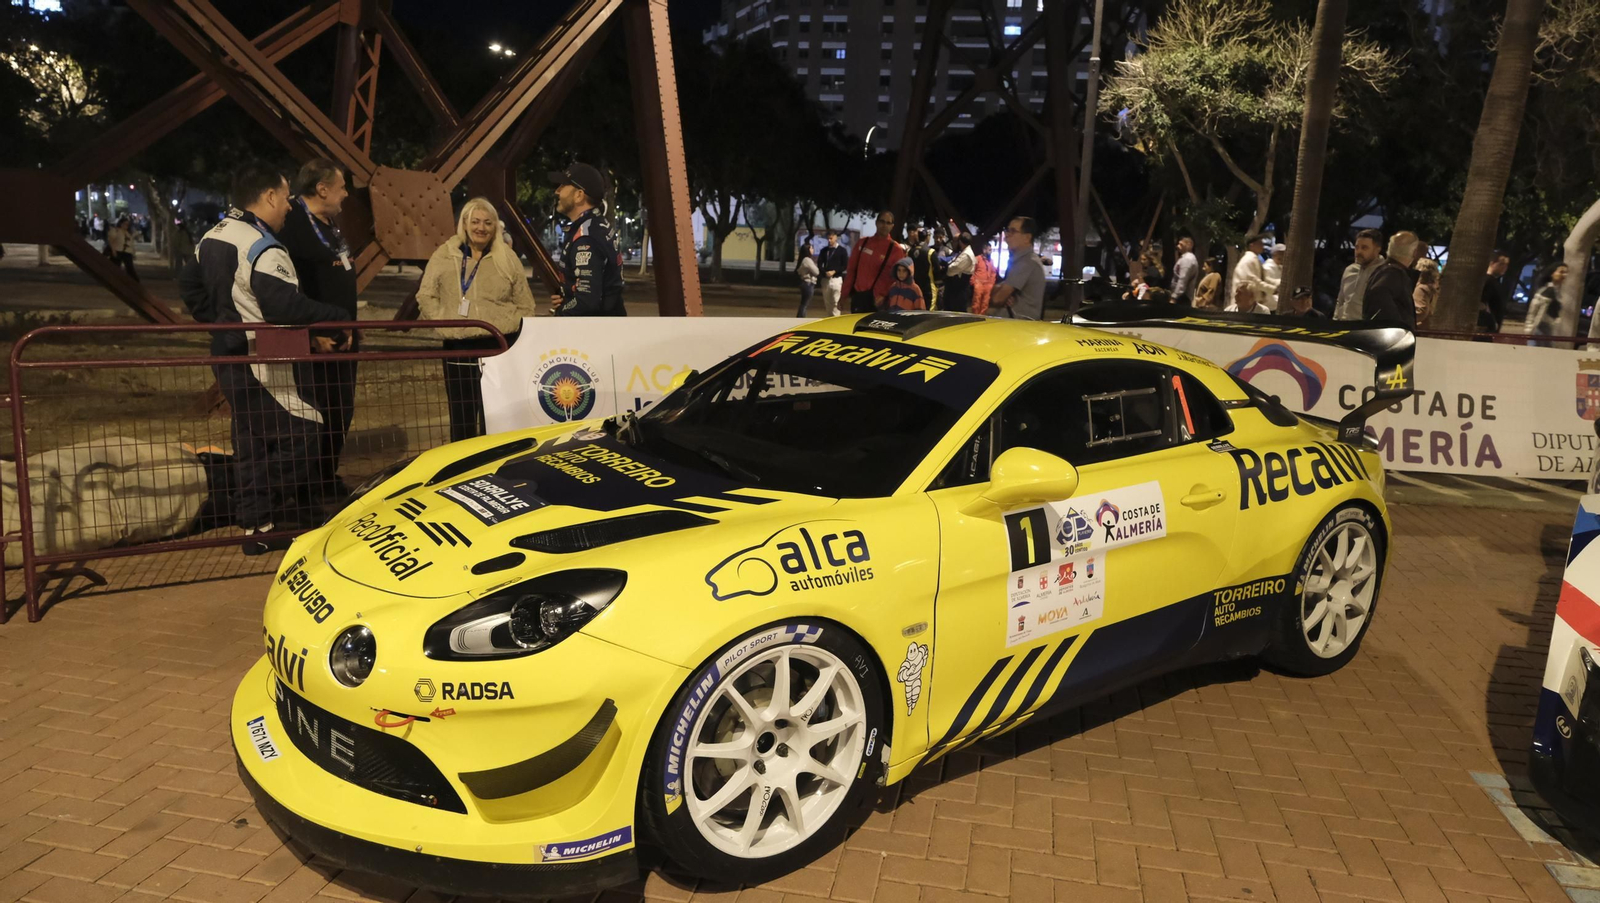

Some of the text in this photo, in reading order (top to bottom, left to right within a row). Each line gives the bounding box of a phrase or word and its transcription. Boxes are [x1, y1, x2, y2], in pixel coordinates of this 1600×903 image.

[791, 338, 918, 371] Recalvi
[1075, 339, 1124, 347] MARINA
[532, 356, 600, 385] AUTOMOVIL CLUB
[626, 364, 691, 393] AC
[1172, 375, 1195, 434] 1
[1457, 393, 1497, 420] DE
[1364, 421, 1503, 469] MERÍA
[1532, 431, 1595, 451] DIPUT
[533, 455, 602, 485] RECAMBIOS
[549, 450, 589, 465] AUTO
[571, 443, 677, 488] TORREIRO
[1536, 455, 1565, 472] DE
[1228, 440, 1372, 511] Recalvi
[1122, 503, 1161, 521] COSTA DE
[1019, 516, 1036, 564] 1
[1115, 515, 1163, 541] ALMERÍA
[776, 527, 871, 575] alca
[1064, 545, 1074, 557] 30
[1302, 518, 1335, 572] MICHELIN
[789, 566, 874, 592] automóviles
[1213, 578, 1286, 607] TORREIRO
[1214, 602, 1236, 617] AUTO
[1214, 606, 1262, 628] RECAMBIOS
[262, 625, 309, 693] alvi
[724, 632, 779, 667] PILOT SPORT
[441, 682, 515, 701] RADSA
[667, 672, 715, 775] MICHELIN
[250, 719, 279, 760] 7671 MZY
[562, 833, 622, 856] MICHELIN
